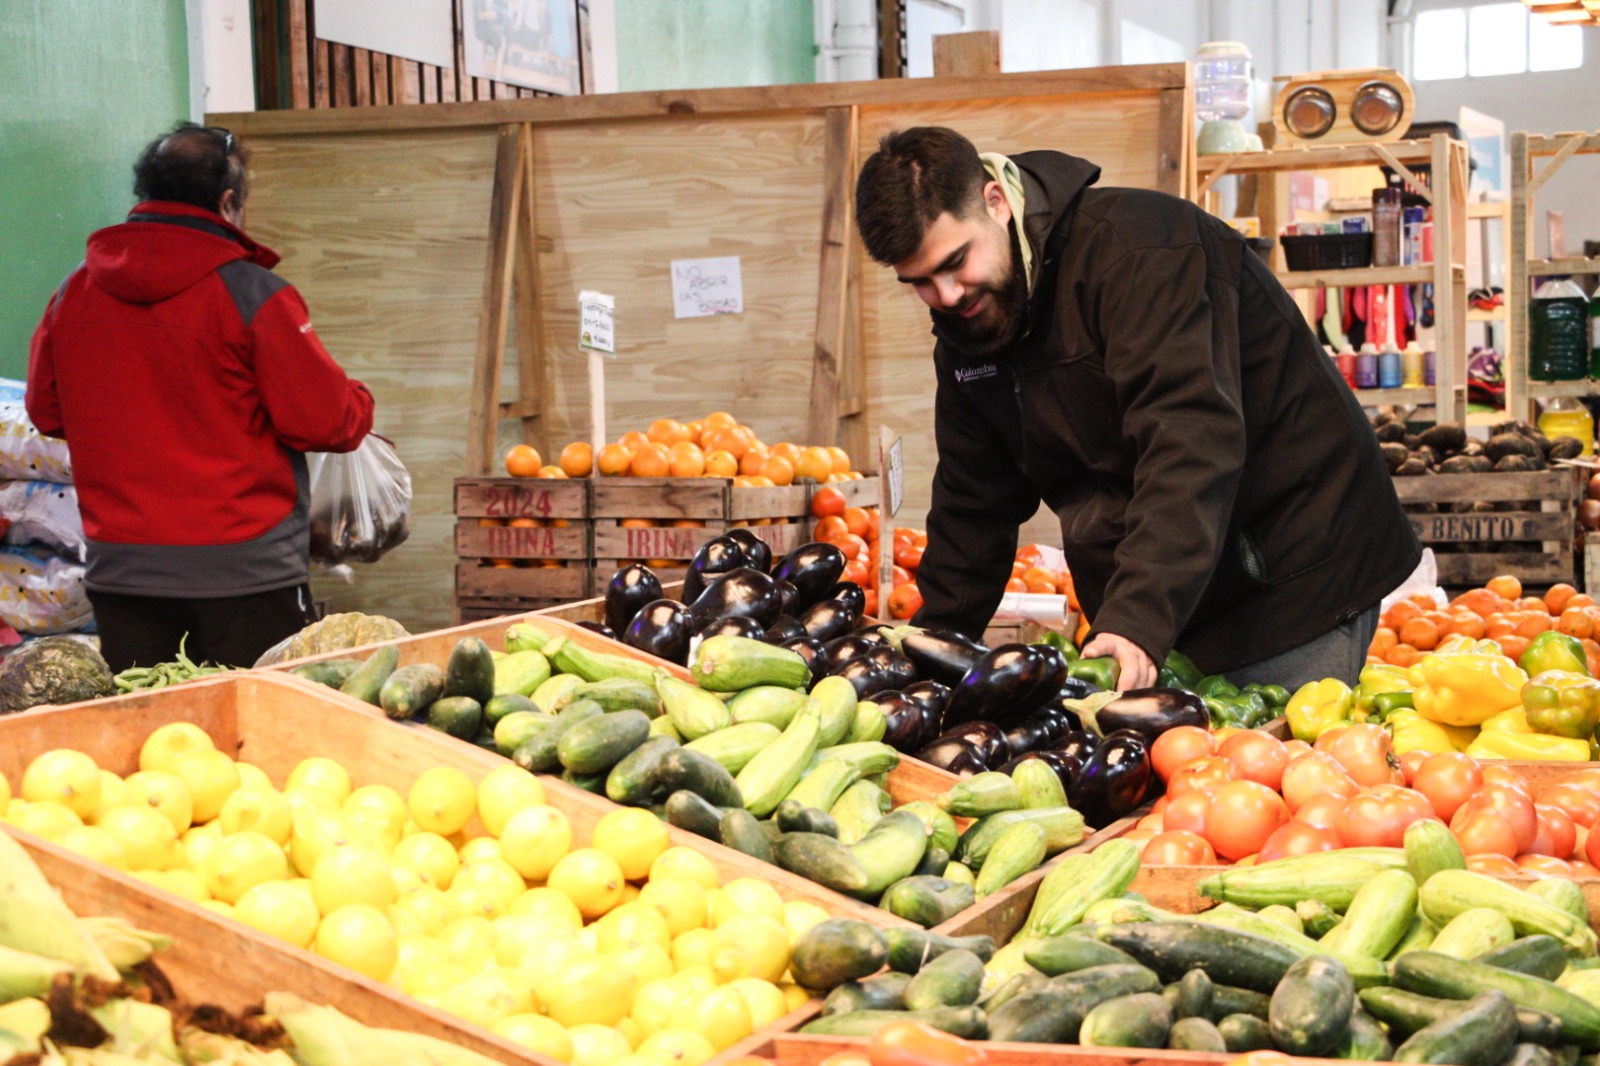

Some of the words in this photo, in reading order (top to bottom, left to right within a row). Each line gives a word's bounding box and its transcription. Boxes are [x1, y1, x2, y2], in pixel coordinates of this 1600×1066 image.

[675, 265, 702, 281] NO
[486, 489, 552, 517] 2024
[488, 528, 555, 556] IRINA
[1431, 516, 1514, 540] BENITO
[626, 529, 695, 557] IRINA
